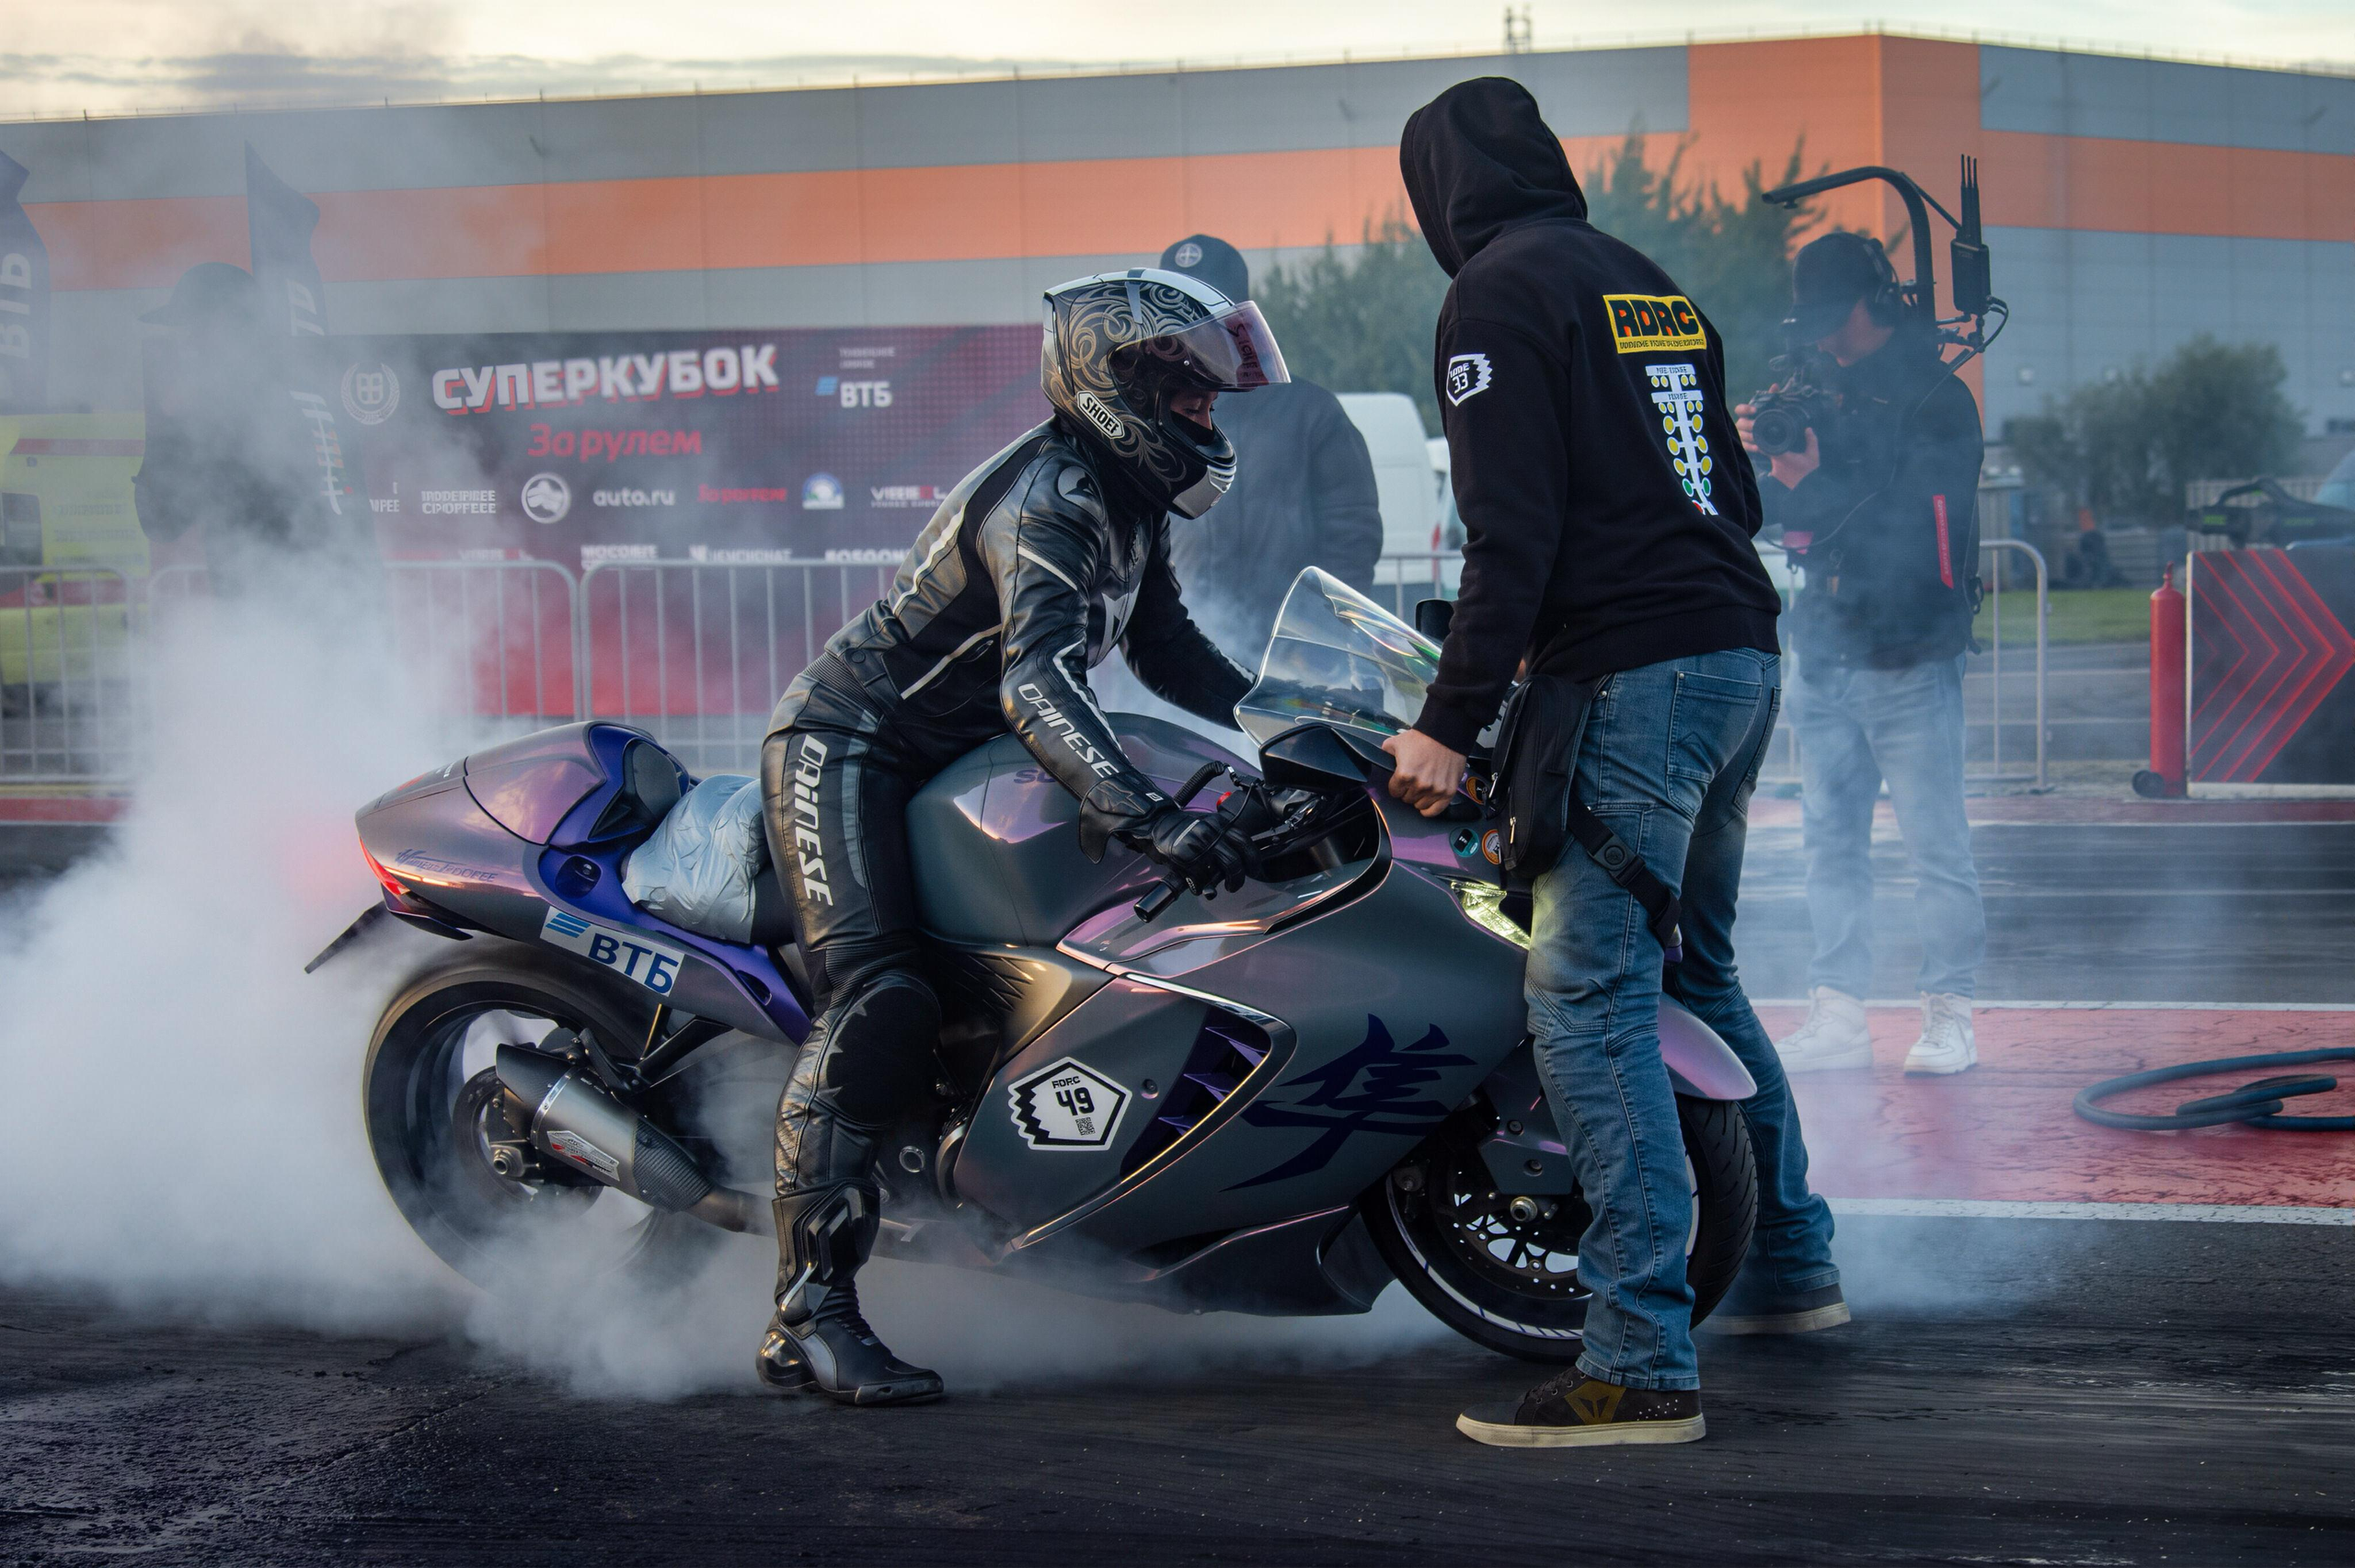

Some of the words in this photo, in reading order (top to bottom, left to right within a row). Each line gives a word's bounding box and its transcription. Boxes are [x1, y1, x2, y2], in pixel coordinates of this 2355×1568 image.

[432, 343, 779, 413] СУПЕРКУБОК
[840, 380, 893, 408] ВТБ
[592, 486, 676, 508] auto.ru
[1017, 682, 1120, 779] DAINESE
[794, 734, 834, 907] DAINESE
[588, 933, 679, 994] ВТБ
[1055, 1087, 1096, 1116] 49
